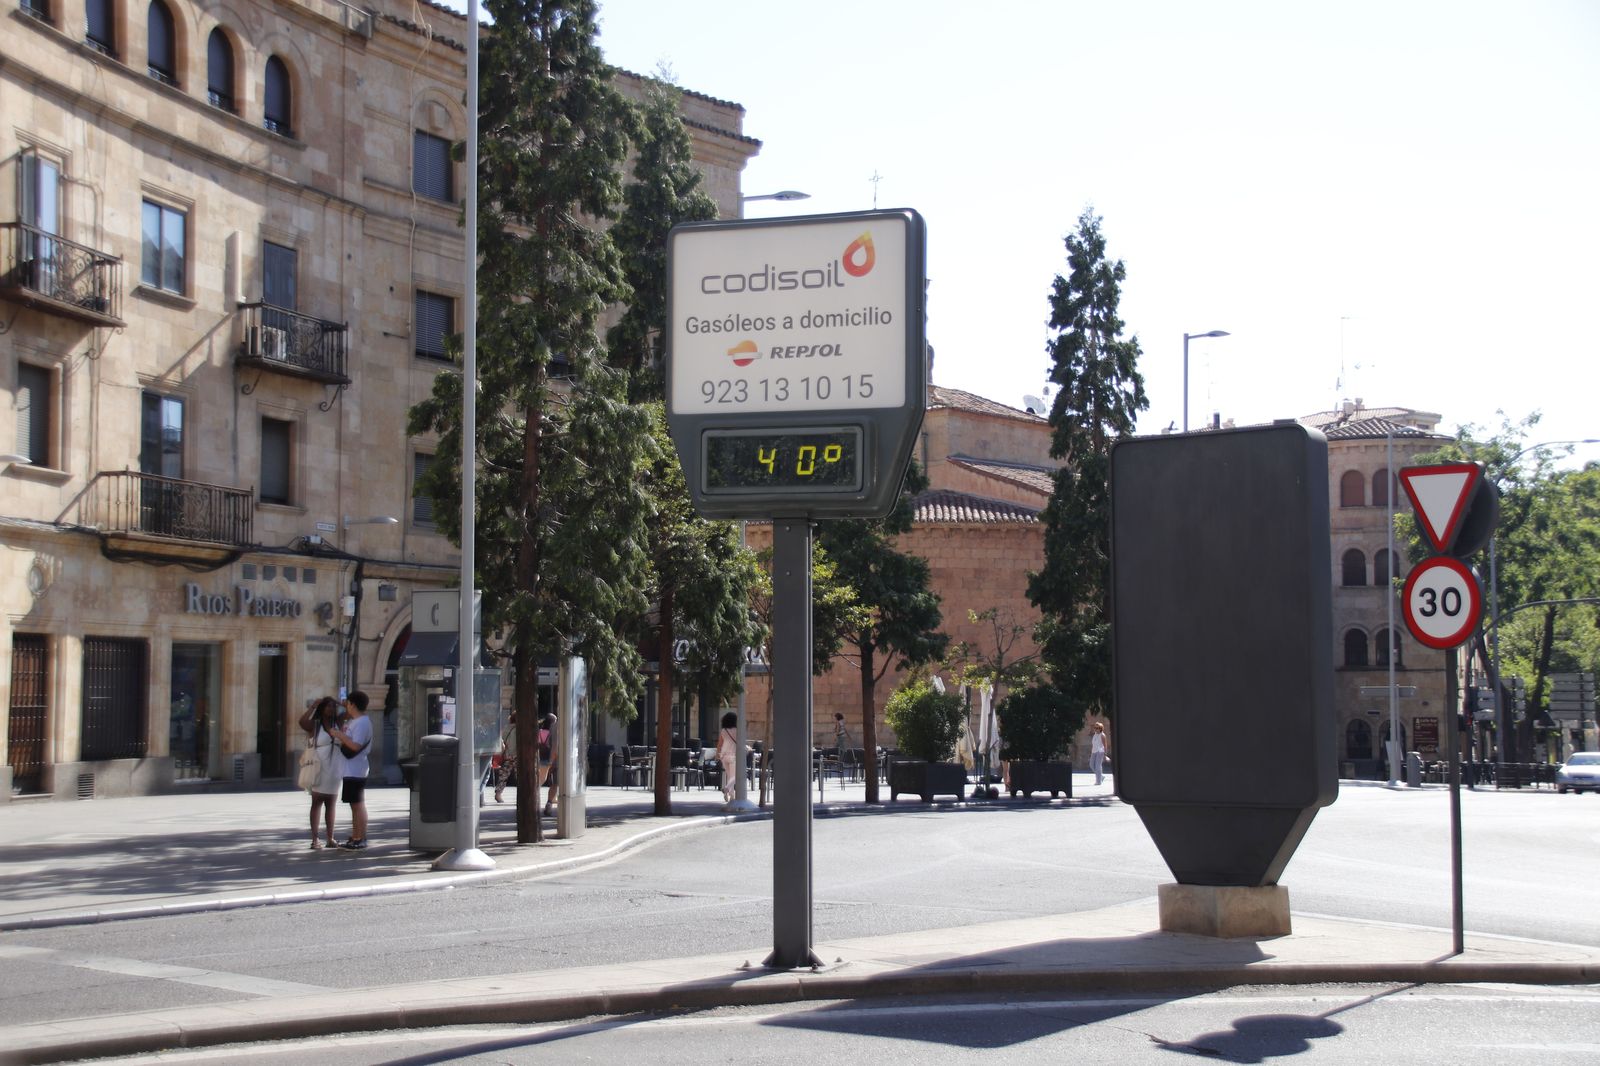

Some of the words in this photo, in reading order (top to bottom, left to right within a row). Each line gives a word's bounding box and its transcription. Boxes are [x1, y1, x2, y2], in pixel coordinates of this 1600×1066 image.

[701, 259, 845, 295] codisoil
[685, 313, 776, 334] Gasóleos
[782, 316, 793, 330] a
[799, 306, 893, 329] domicilio
[770, 343, 843, 360] REPSOL
[701, 379, 748, 404] 923
[759, 378, 789, 402] 13
[800, 375, 831, 400] 10
[842, 374, 874, 399] 15
[1418, 586, 1462, 617] 30
